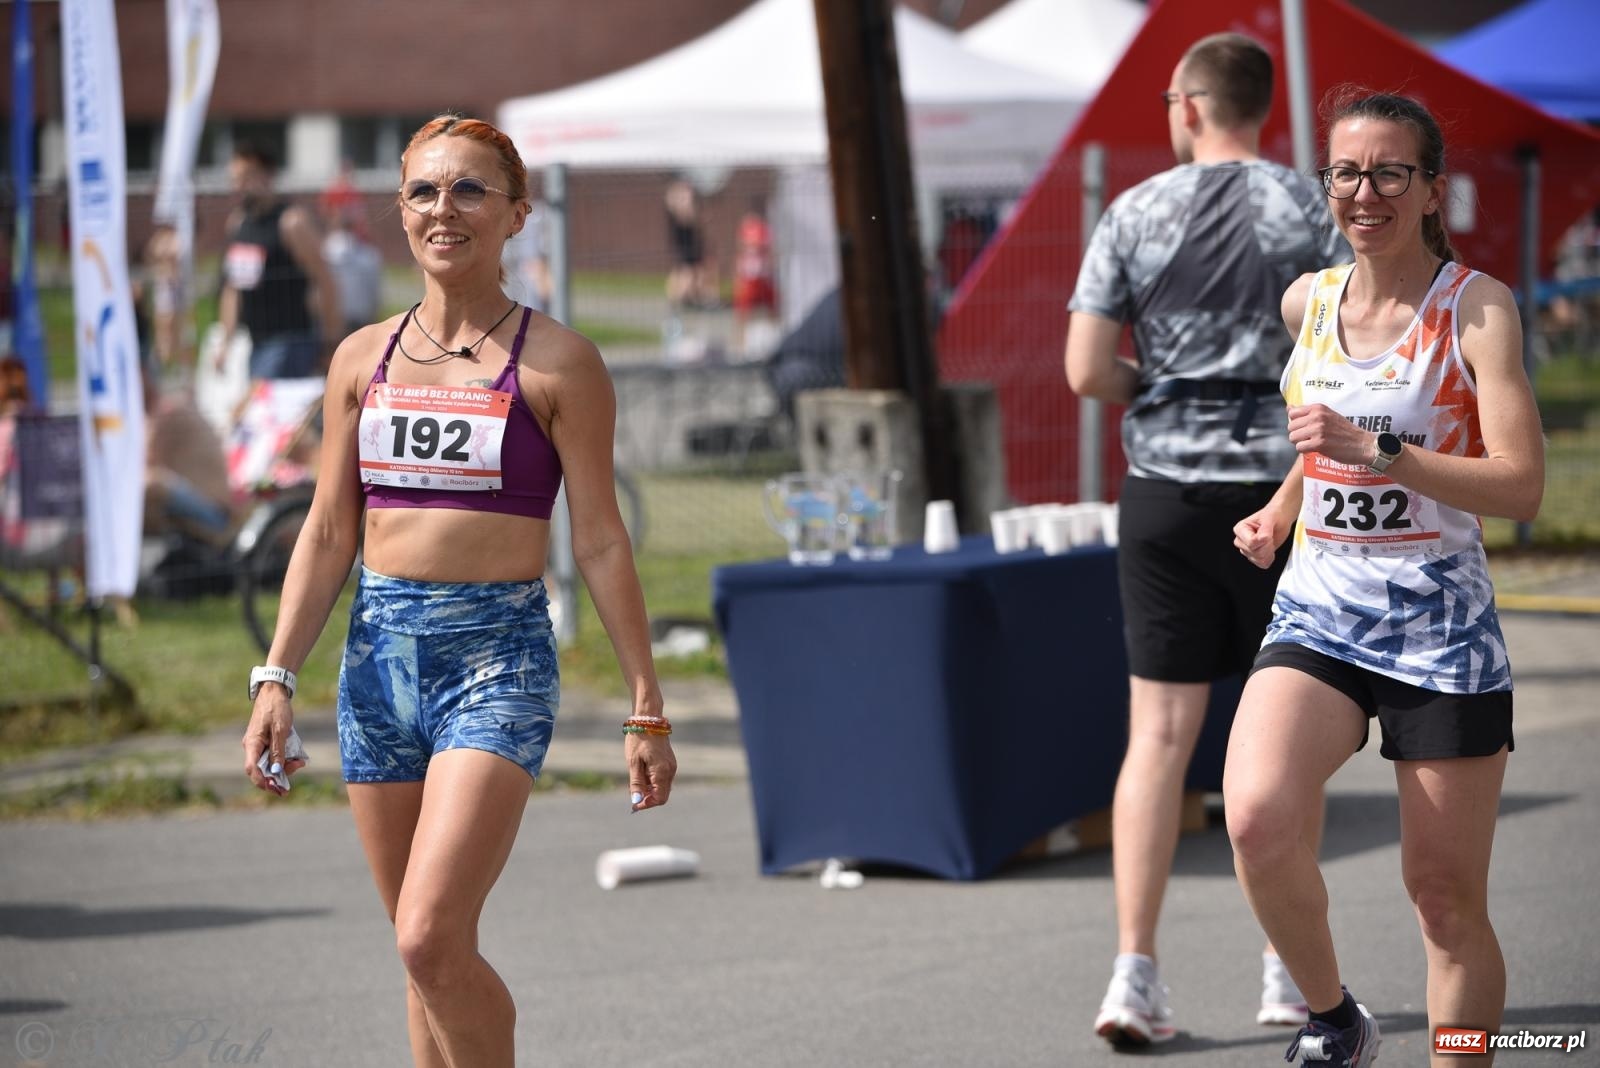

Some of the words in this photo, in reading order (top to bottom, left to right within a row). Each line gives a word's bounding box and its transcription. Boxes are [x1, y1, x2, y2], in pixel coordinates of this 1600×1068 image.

[383, 386, 403, 396] XVI
[403, 387, 429, 398] BIEG
[429, 389, 449, 399] BEZ
[449, 391, 493, 403] GRANIC
[1357, 415, 1393, 432] BIEG
[390, 415, 472, 462] 192
[1315, 456, 1329, 466] XVI
[1329, 459, 1348, 470] BIEG
[1348, 464, 1367, 472] BEZ
[1323, 488, 1412, 531] 232
